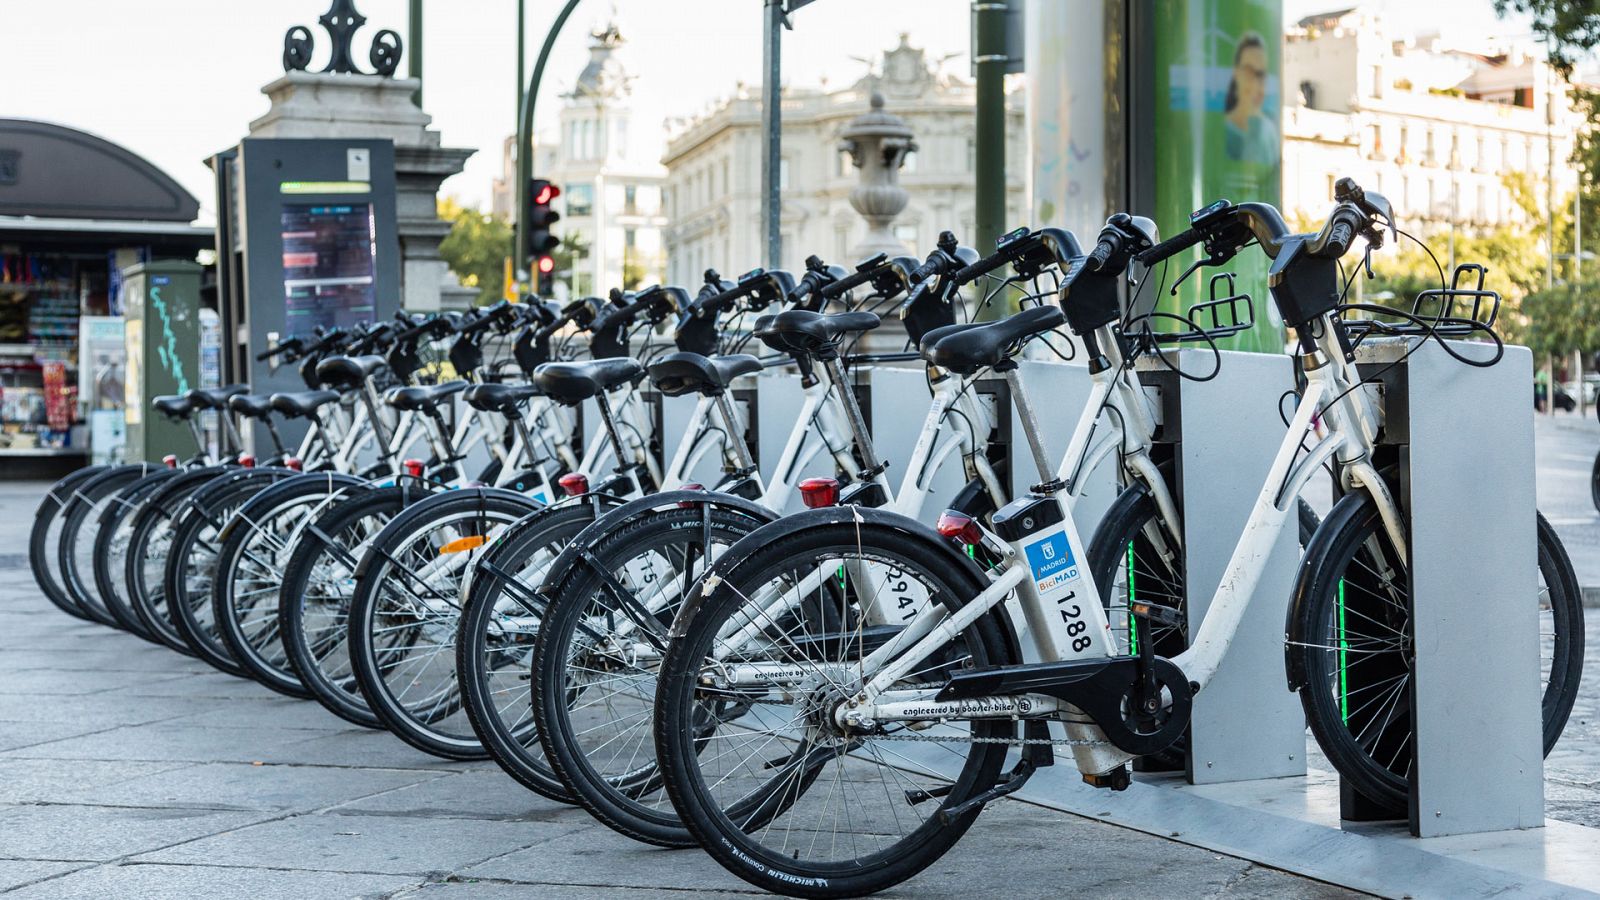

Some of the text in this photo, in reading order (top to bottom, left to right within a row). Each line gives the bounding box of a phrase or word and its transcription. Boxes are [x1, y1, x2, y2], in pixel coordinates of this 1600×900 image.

[683, 521, 725, 529] MICLIN
[1040, 558, 1066, 573] MADRID
[1039, 569, 1077, 591] BiciMAD
[885, 567, 918, 621] 2941
[1057, 591, 1092, 652] 1288
[904, 704, 1015, 716] engineered by booster-bikes
[738, 852, 765, 872] Country
[767, 869, 815, 887] MICHELIN
